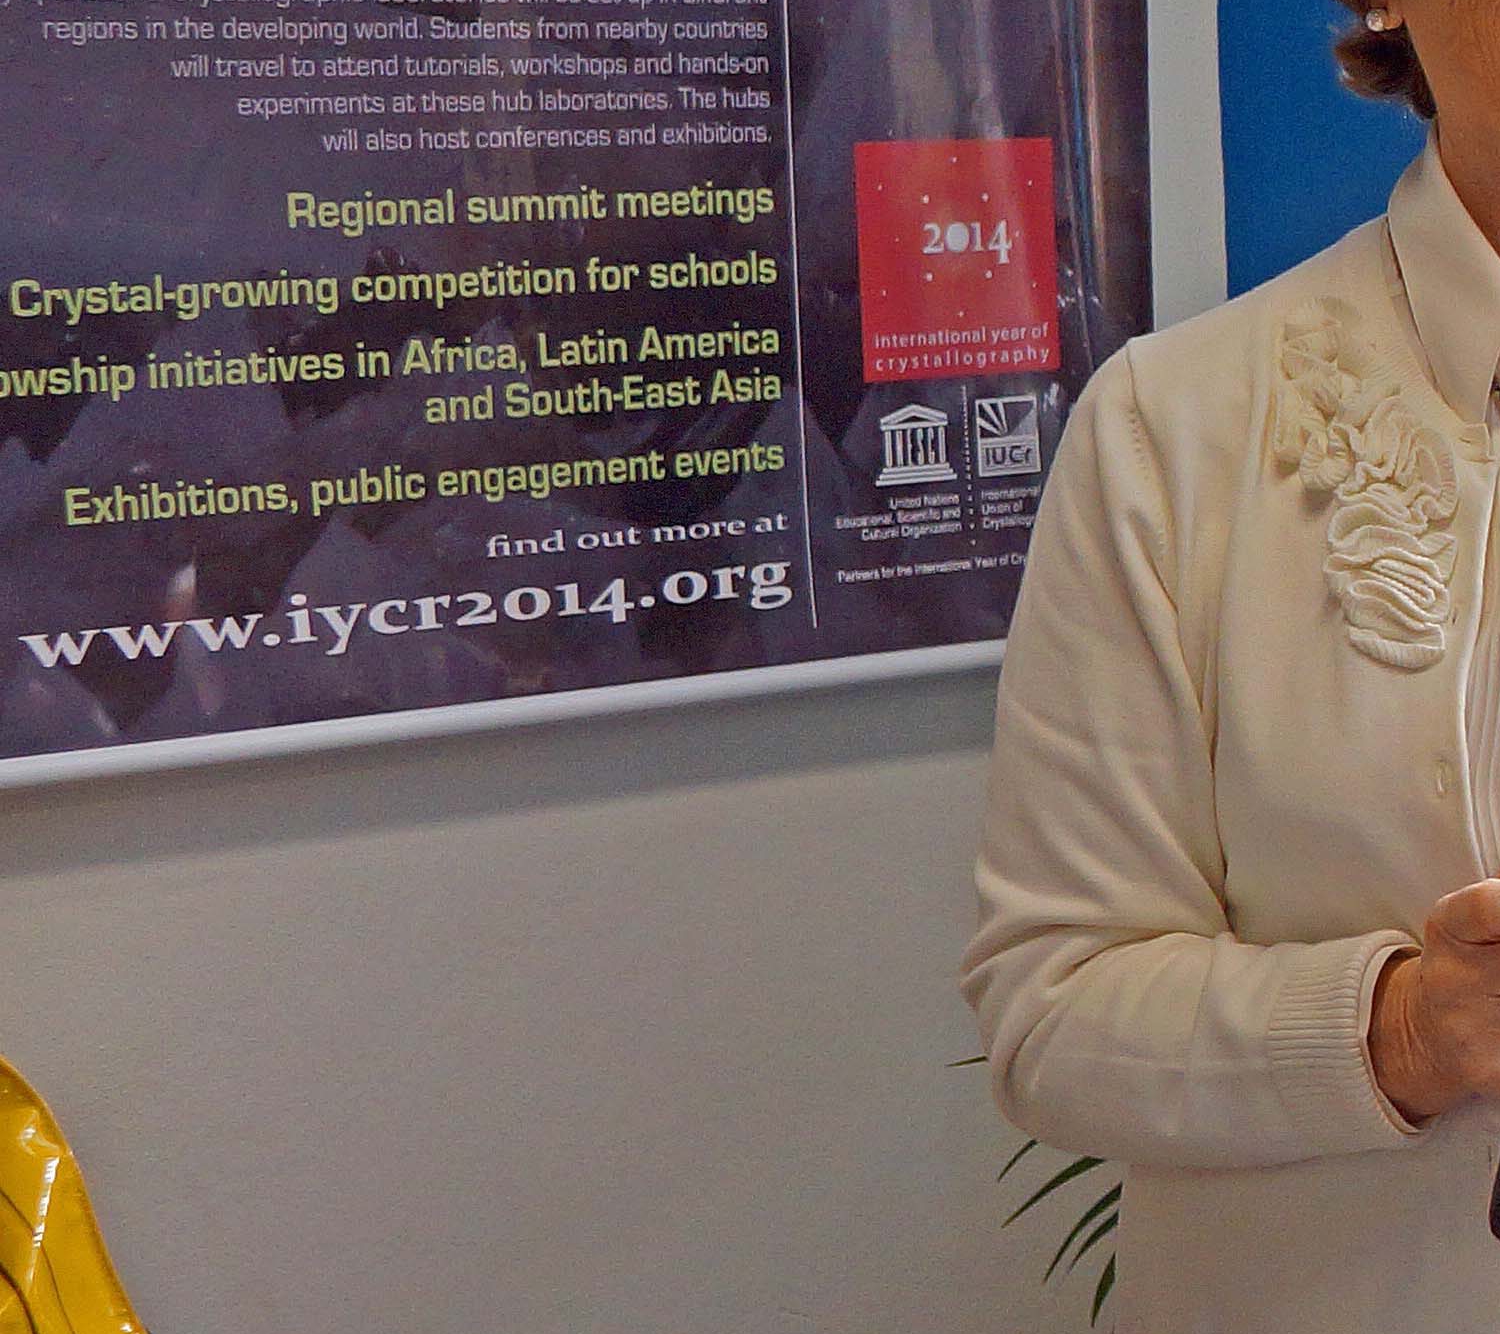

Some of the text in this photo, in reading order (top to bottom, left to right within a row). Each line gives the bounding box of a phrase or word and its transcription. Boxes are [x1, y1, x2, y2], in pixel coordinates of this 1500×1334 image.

[288, 181, 774, 235] Regional summit meetings
[922, 219, 1013, 263] 2014
[11, 251, 777, 324] Crystal-growing competition for schools
[149, 346, 344, 388] initiatives
[357, 342, 389, 377] in
[403, 337, 525, 374] Africa,
[538, 329, 627, 366] Latin
[639, 321, 779, 360] America
[875, 322, 1048, 347] international year of
[876, 345, 1049, 373] crystallography
[426, 367, 780, 422] and South-East Asia
[65, 442, 784, 524] Exhibitions, public engagement events
[487, 514, 786, 557] find out more at
[18, 562, 792, 667] www.iycr2014.org
